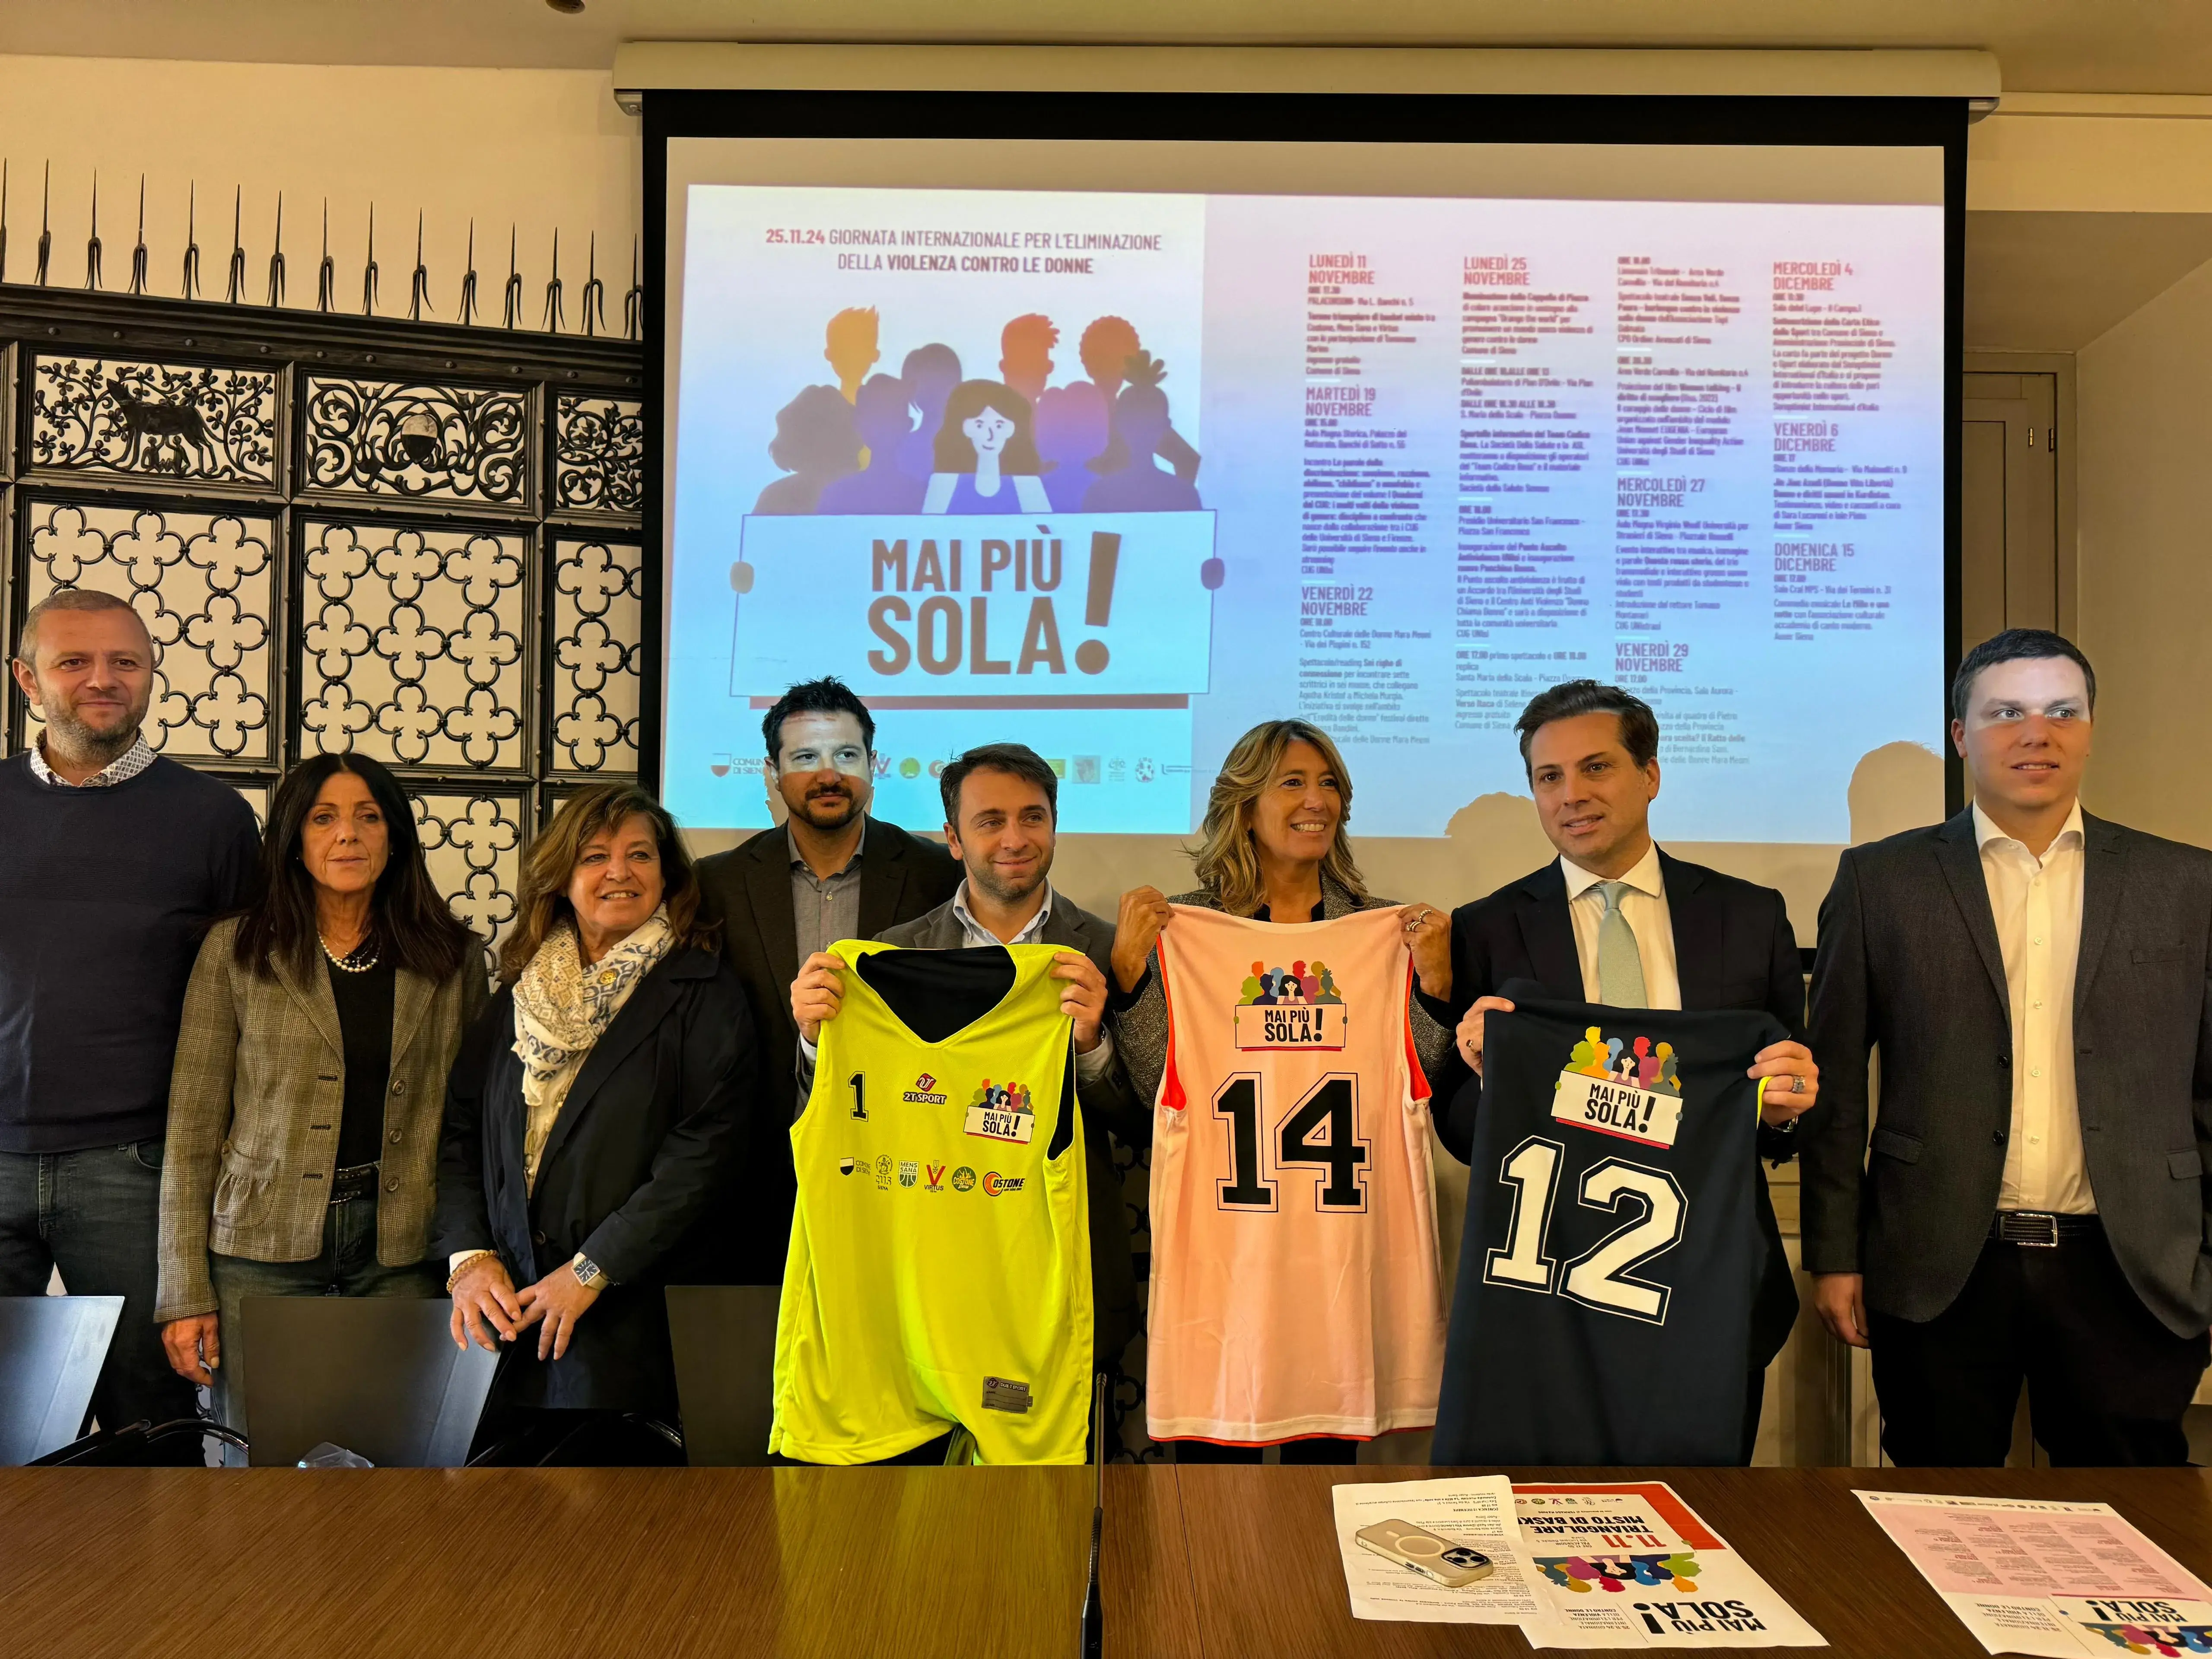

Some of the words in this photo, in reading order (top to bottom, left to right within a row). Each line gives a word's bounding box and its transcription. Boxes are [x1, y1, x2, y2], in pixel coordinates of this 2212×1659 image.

[766, 229, 824, 245] 25.11.24
[829, 230, 896, 246] GIORNATA
[901, 231, 1020, 248] INTERNAZIONALE
[1024, 233, 1052, 248] PER
[1056, 233, 1161, 251] L'ELIMINAZIONE
[838, 254, 884, 271] DELLA
[888, 255, 957, 272] VIOLENZA
[961, 256, 1019, 273] CONTRO
[1023, 257, 1040, 273] LE
[1044, 257, 1093, 274] DONNE
[1309, 251, 1353, 268] LUNEDÌ
[1357, 255, 1366, 267] 11
[1464, 253, 1508, 270] LUNEDÌ
[1511, 258, 1526, 270] 25
[1773, 259, 1840, 275] MERCOLEDÌ
[1844, 263, 1853, 276] 4
[1309, 270, 1375, 285] NOVEMBRE
[1464, 272, 1530, 286] NOVEMBRE
[1773, 277, 1834, 291] DICEMBRE
[1306, 383, 1360, 401] MARTEDÌ
[1364, 388, 1376, 401] 19
[1306, 402, 1373, 416] NOVEMBRE
[1774, 420, 1827, 436] VENERDÌ
[1831, 424, 1839, 436] 6
[1774, 438, 1836, 452] DICEMBRE
[1617, 475, 1687, 492] MERCOLEDÌ
[1690, 479, 1705, 492] 27
[1618, 493, 1684, 507] NOVEMBRE
[1774, 543, 1837, 557] DOMENICA
[1842, 543, 1854, 557] 15
[872, 539, 961, 592] MAI
[981, 525, 1062, 592] PIÙ
[1775, 558, 1837, 572] DICEMBRE
[1302, 584, 1354, 600] VENERDÌ
[1358, 587, 1373, 601] 22
[1301, 601, 1367, 616] NOVEMBRE
[1615, 640, 1669, 657] VENERDÌ
[1673, 643, 1688, 657] 29
[1615, 658, 1683, 672] NOVEMBRE
[732, 758, 765, 766] COMUN
[1265, 1010, 1286, 1023] MAI
[1290, 1007, 1309, 1023] PIÙ
[848, 1070, 869, 1122] 1
[917, 1093, 947, 1105] SPORT
[1589, 1083, 1614, 1102] MAI
[1618, 1090, 1640, 1109] PIÙ
[984, 1111, 998, 1121] MAI
[998, 1112, 1012, 1124] PIÙ
[1211, 1072, 1372, 1213] 14
[1483, 1135, 1689, 1326] 12
[1569, 1516, 1587, 1524] DI
[1590, 1516, 1644, 1524] MISTO
[1530, 1525, 1654, 1534] TRIANGOLARE
[1601, 1535, 1667, 1548] 11.11
[1717, 1618, 1767, 1631] MAI
[2114, 1613, 2150, 1623] PIÙ
[2149, 1614, 2188, 1622] MAI
[1670, 1619, 1718, 1634] PIÙ
